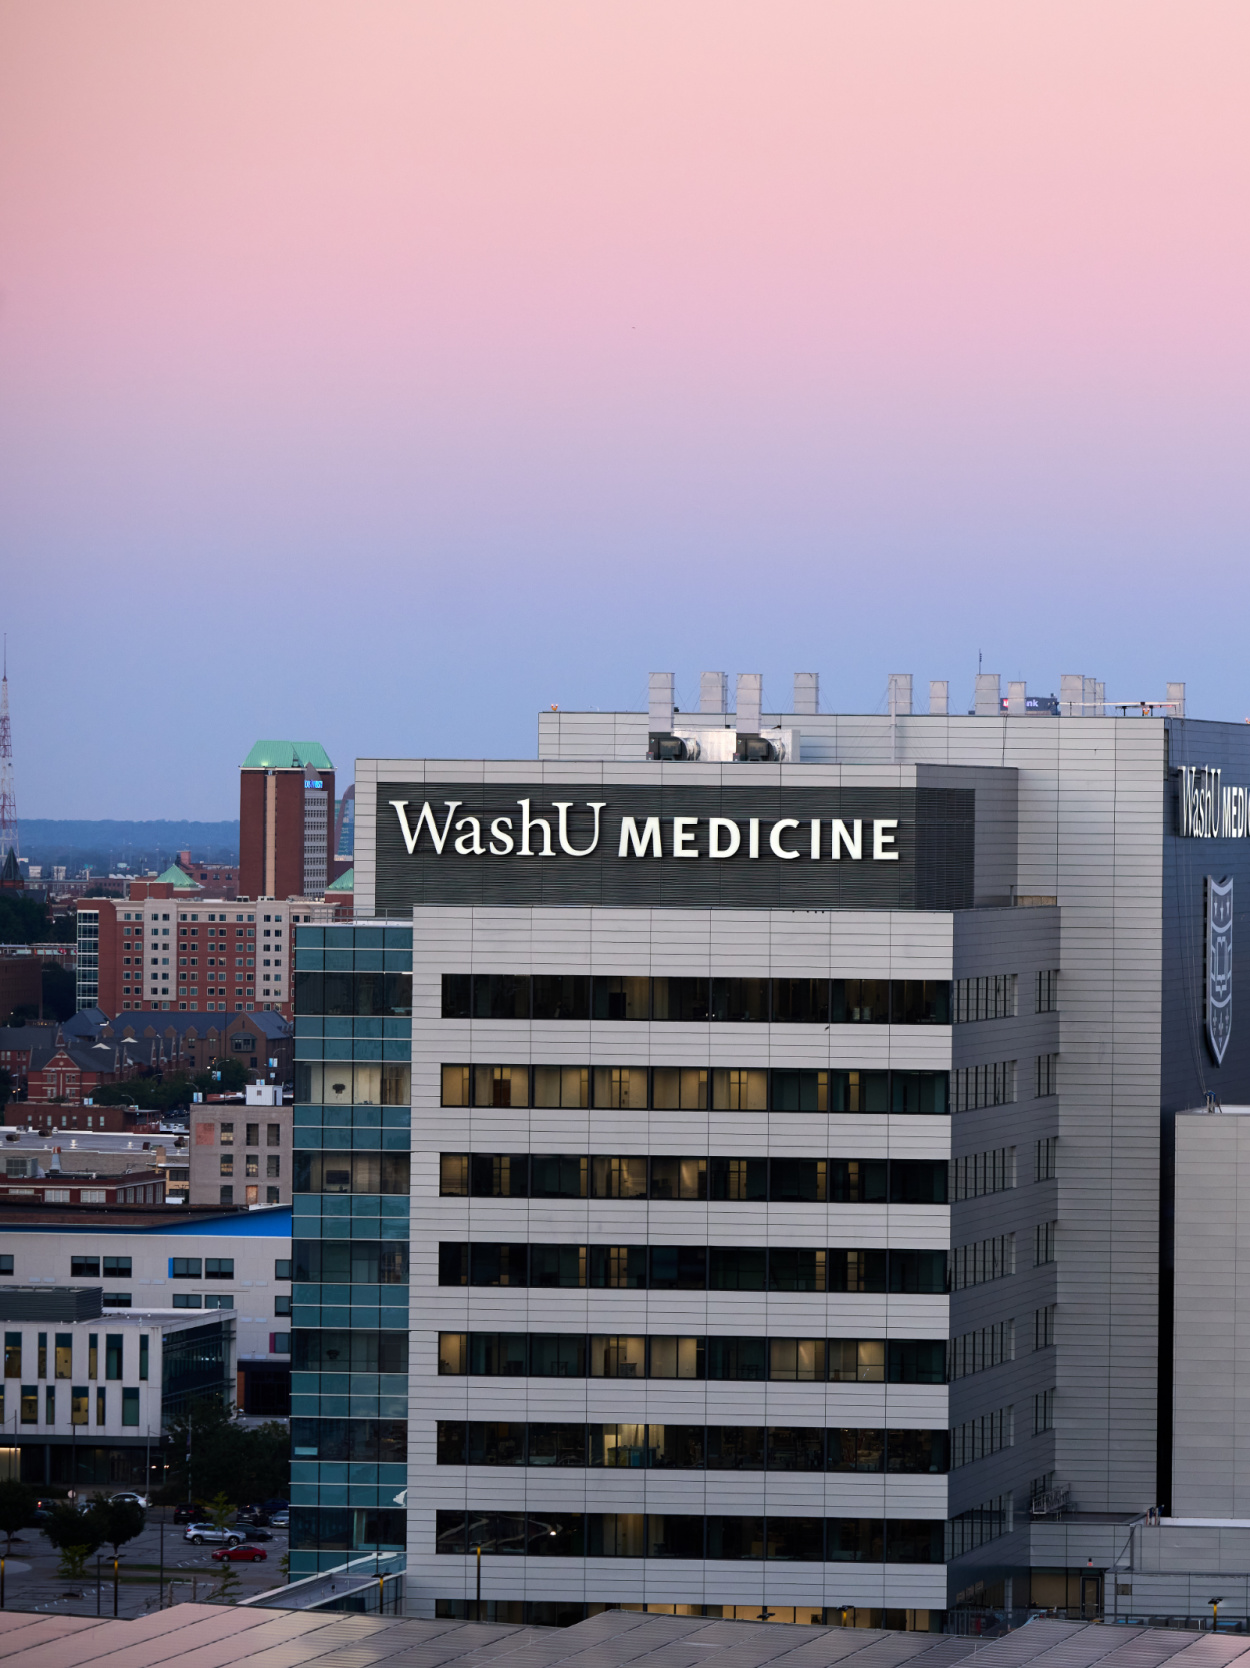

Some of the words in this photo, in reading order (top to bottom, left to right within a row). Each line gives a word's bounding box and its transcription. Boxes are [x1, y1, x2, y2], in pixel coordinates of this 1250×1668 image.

[389, 798, 606, 857] WashU
[618, 816, 899, 861] MEDICINE
[1178, 764, 1221, 838] WashU
